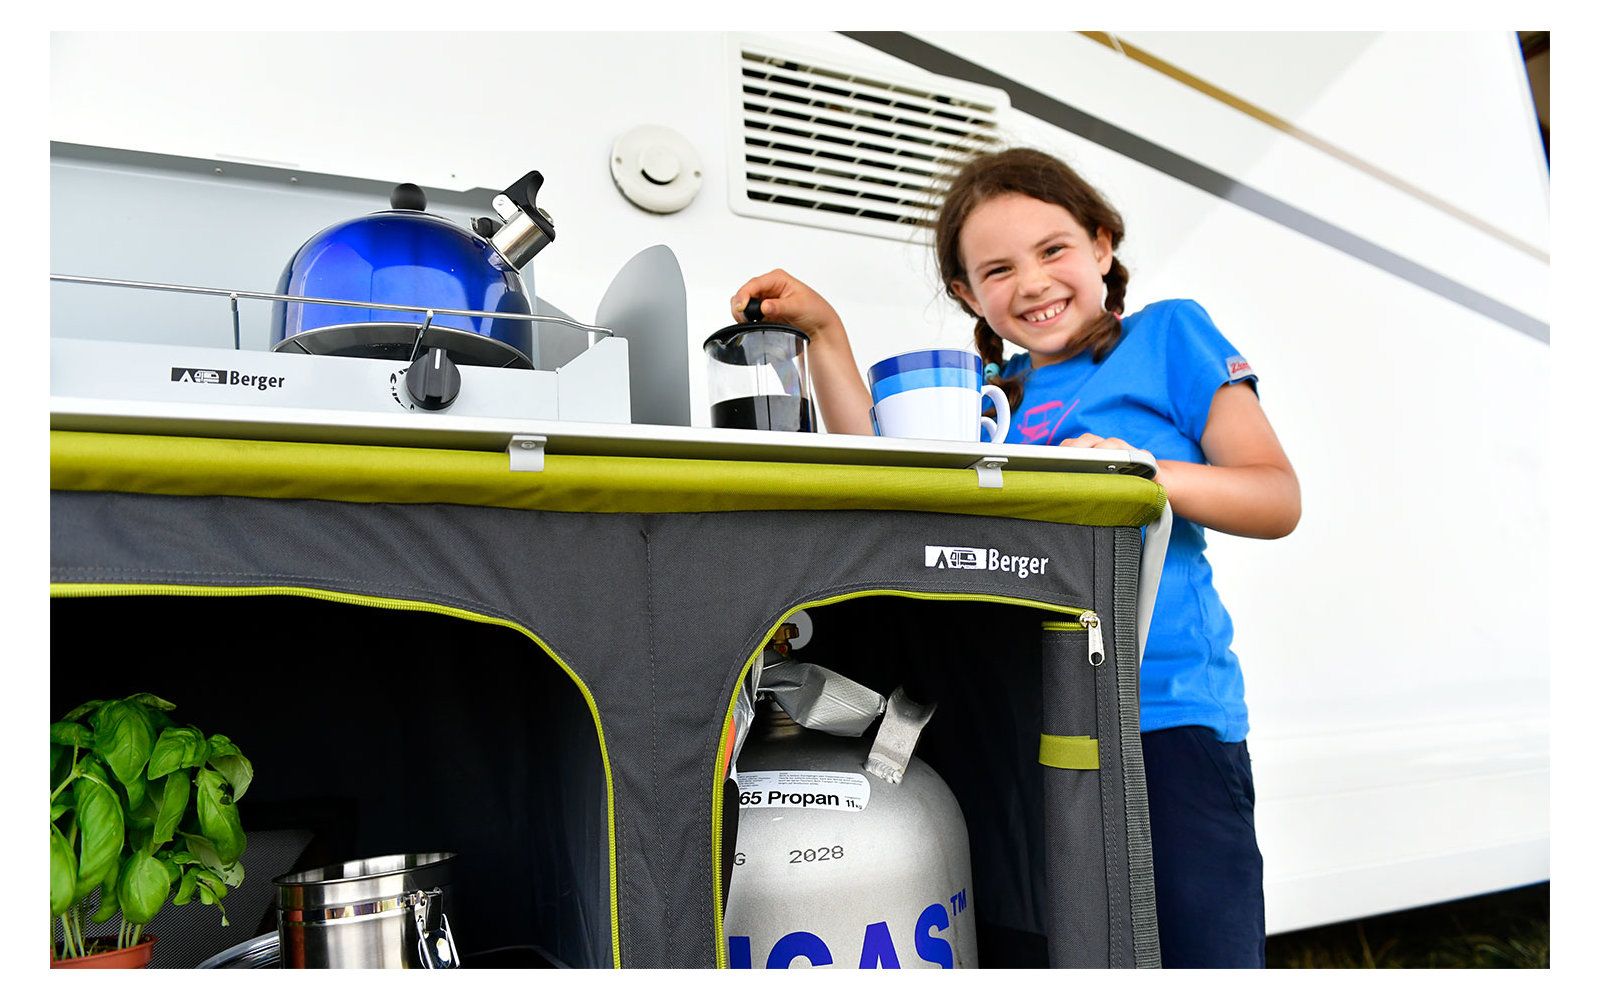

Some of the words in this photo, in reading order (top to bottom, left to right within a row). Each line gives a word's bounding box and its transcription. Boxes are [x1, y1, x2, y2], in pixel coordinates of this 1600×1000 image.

[230, 370, 285, 391] Berger
[988, 548, 1049, 579] Berger
[767, 791, 839, 807] Propan
[789, 845, 844, 864] 2028
